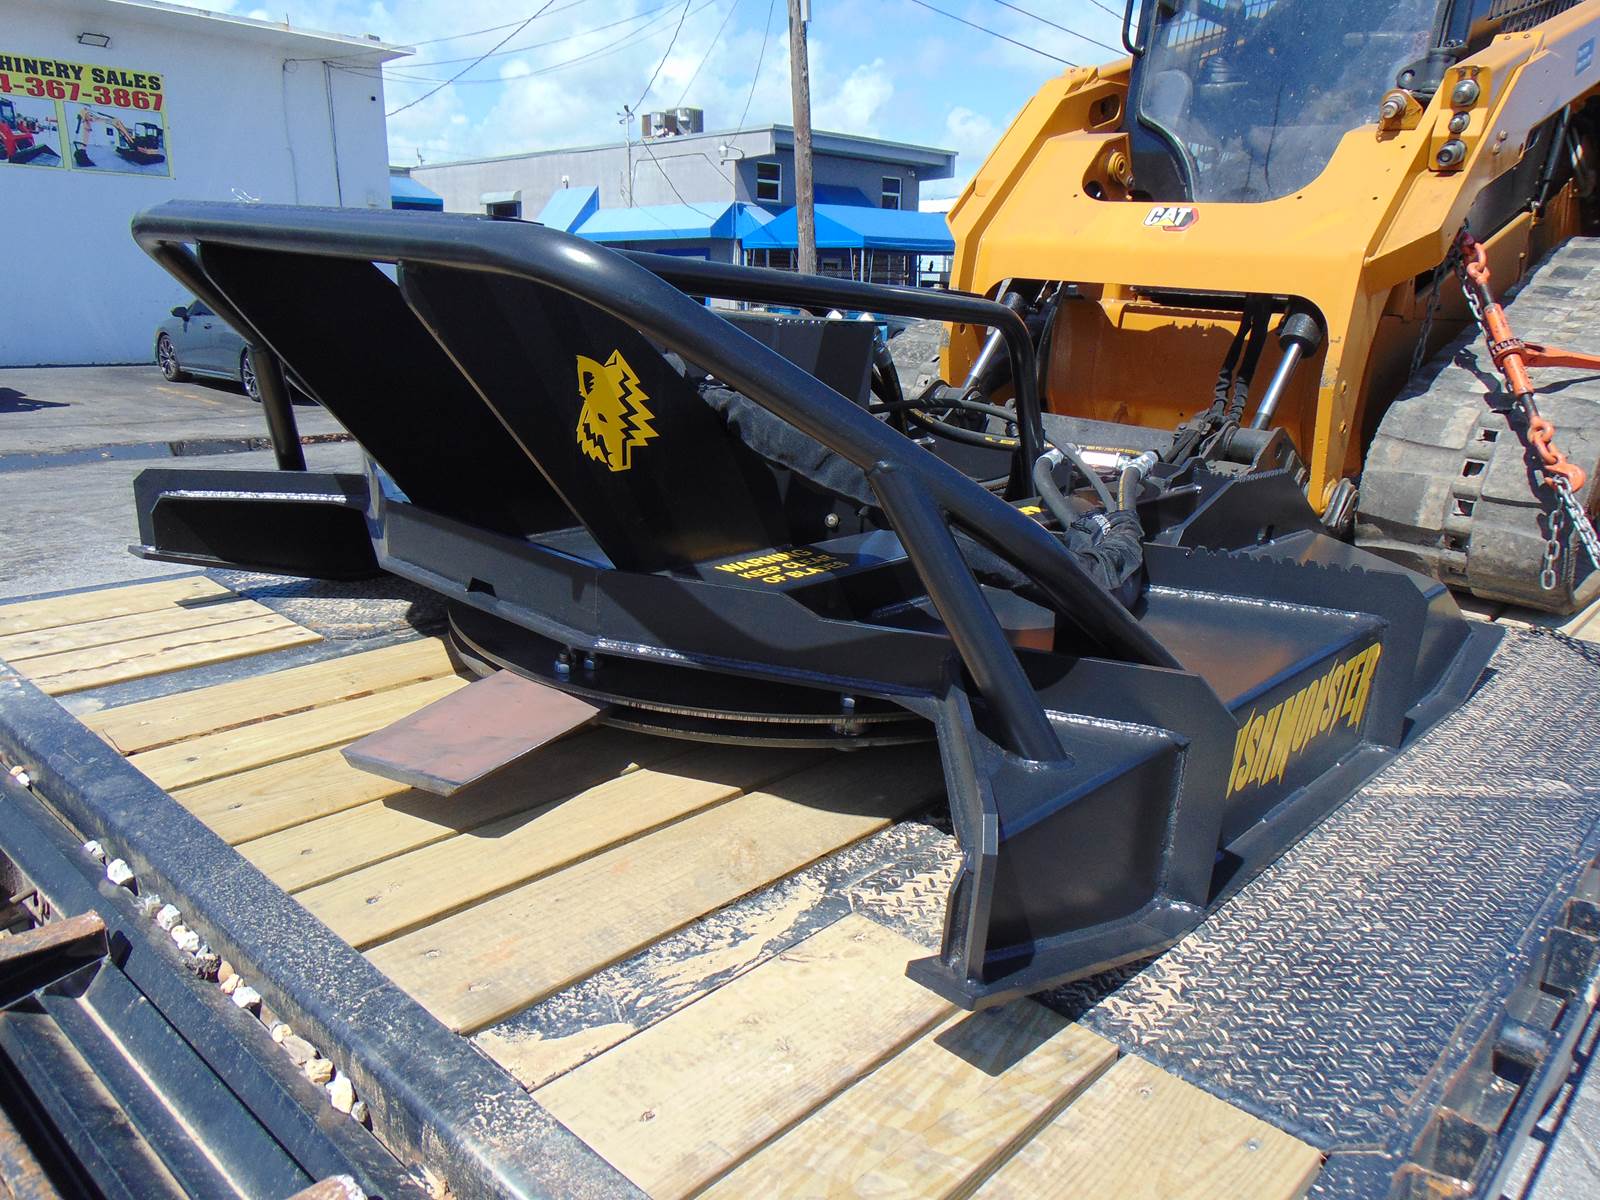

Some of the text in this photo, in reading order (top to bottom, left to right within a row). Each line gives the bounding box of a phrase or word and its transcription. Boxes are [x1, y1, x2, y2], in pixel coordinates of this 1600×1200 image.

[0, 54, 161, 90] HINERY SALES
[1144, 207, 1192, 226] CAT
[715, 549, 813, 573] WARNING
[738, 554, 837, 579] KEEP CLEAR
[762, 561, 849, 583] OF BLADES
